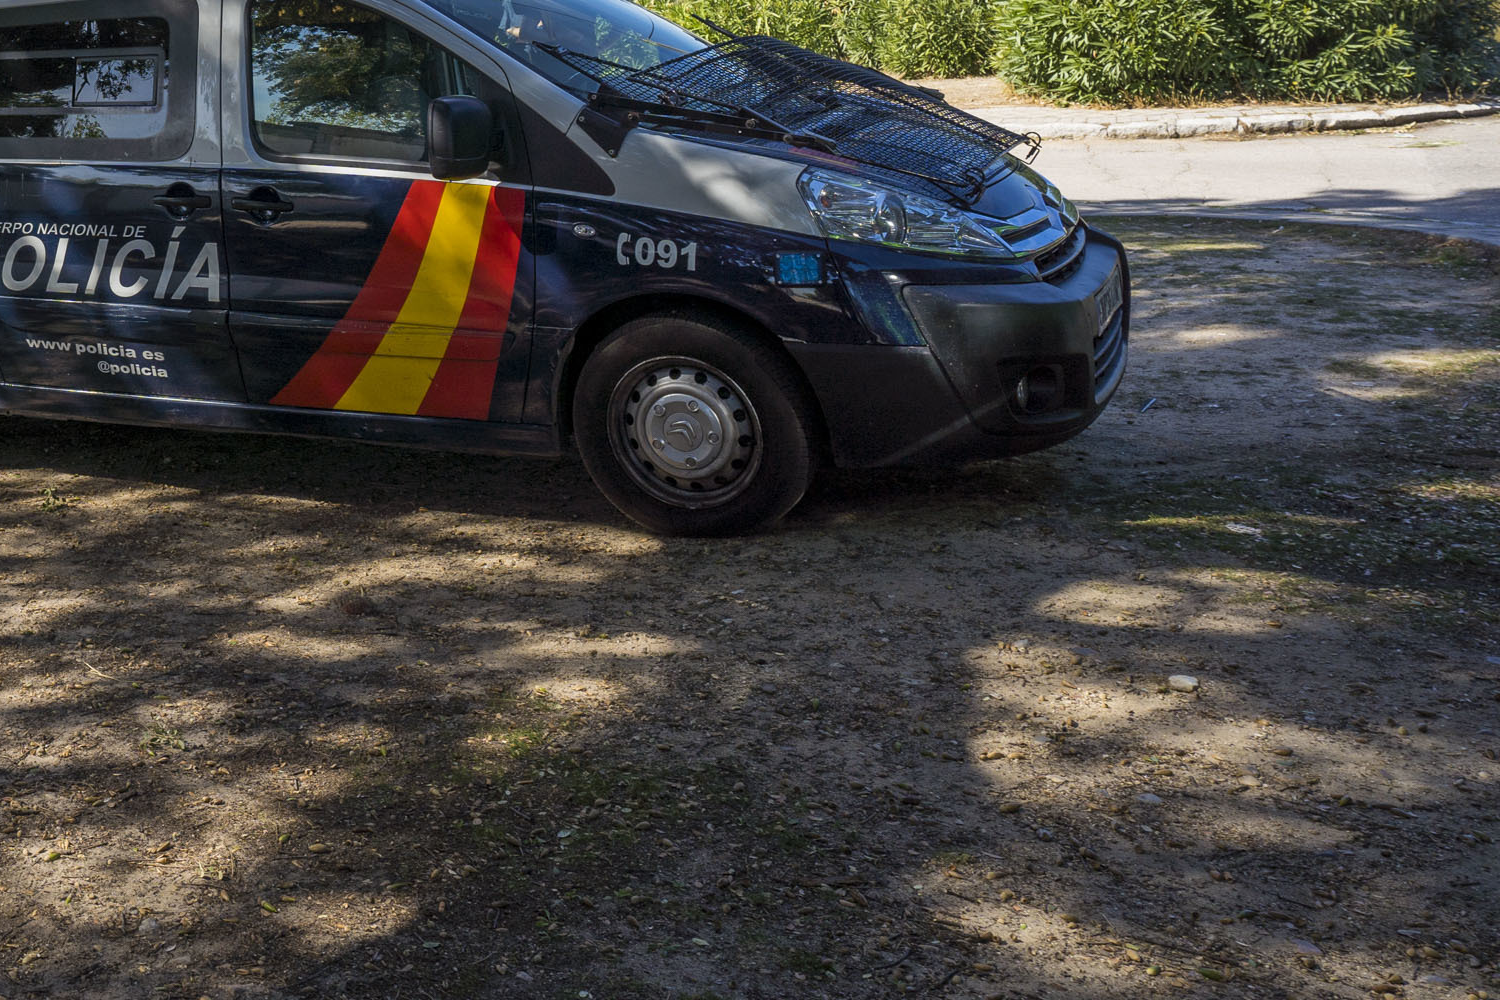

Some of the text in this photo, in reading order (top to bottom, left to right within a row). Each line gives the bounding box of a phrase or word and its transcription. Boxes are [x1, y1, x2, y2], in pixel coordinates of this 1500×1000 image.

[37, 222, 118, 238] NACIONAL
[122, 225, 147, 238] DE
[635, 236, 697, 271] 091
[97, 361, 169, 378] @policia
